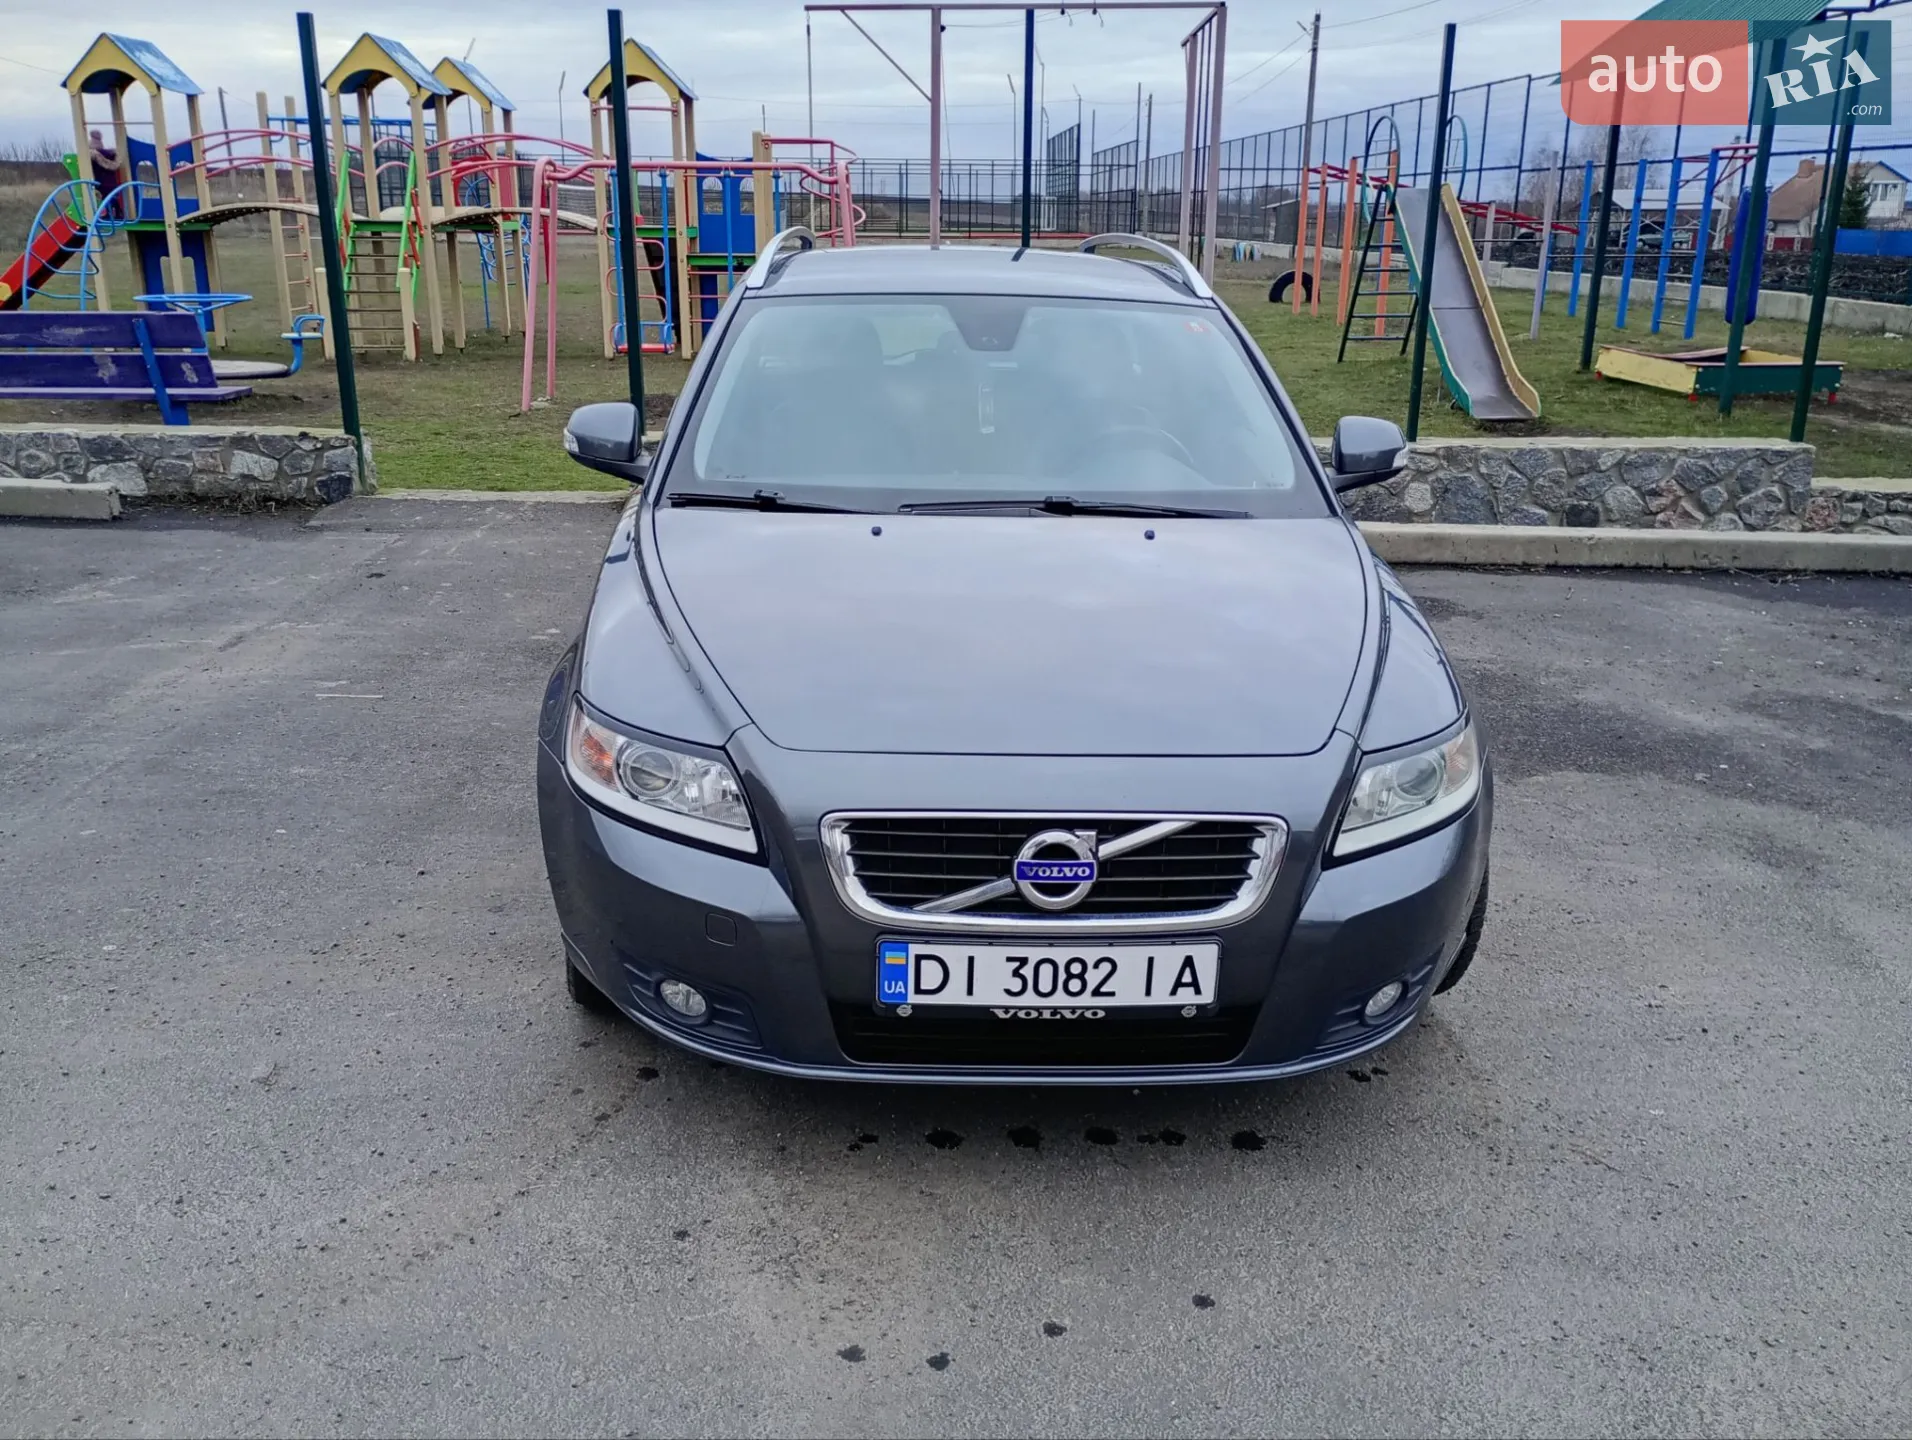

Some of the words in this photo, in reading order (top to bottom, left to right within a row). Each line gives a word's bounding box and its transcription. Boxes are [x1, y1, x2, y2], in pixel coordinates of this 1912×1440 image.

[1020, 866, 1091, 877] VOLVO
[914, 953, 975, 997] DI
[1003, 955, 1118, 998] 3082
[1144, 954, 1203, 997] IA
[884, 980, 906, 995] UA
[989, 1008, 1106, 1020] VOLVO
